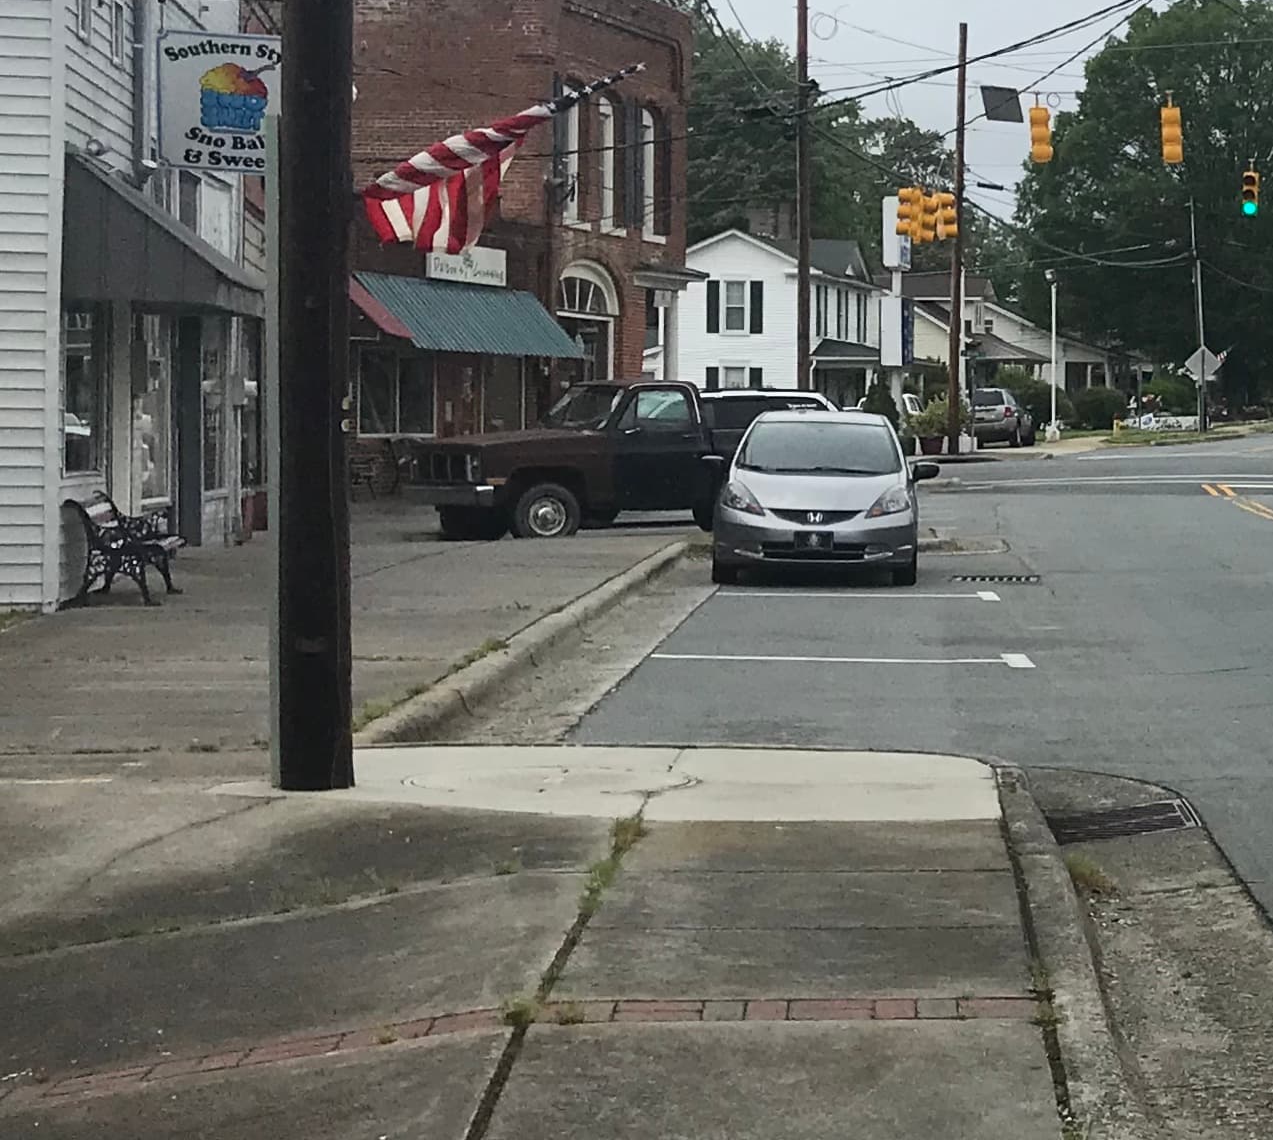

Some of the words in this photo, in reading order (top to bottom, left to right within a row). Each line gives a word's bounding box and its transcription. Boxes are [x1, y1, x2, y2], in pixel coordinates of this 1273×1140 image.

[164, 40, 251, 61] Southern
[185, 127, 226, 148] Sno
[184, 148, 202, 163] &
